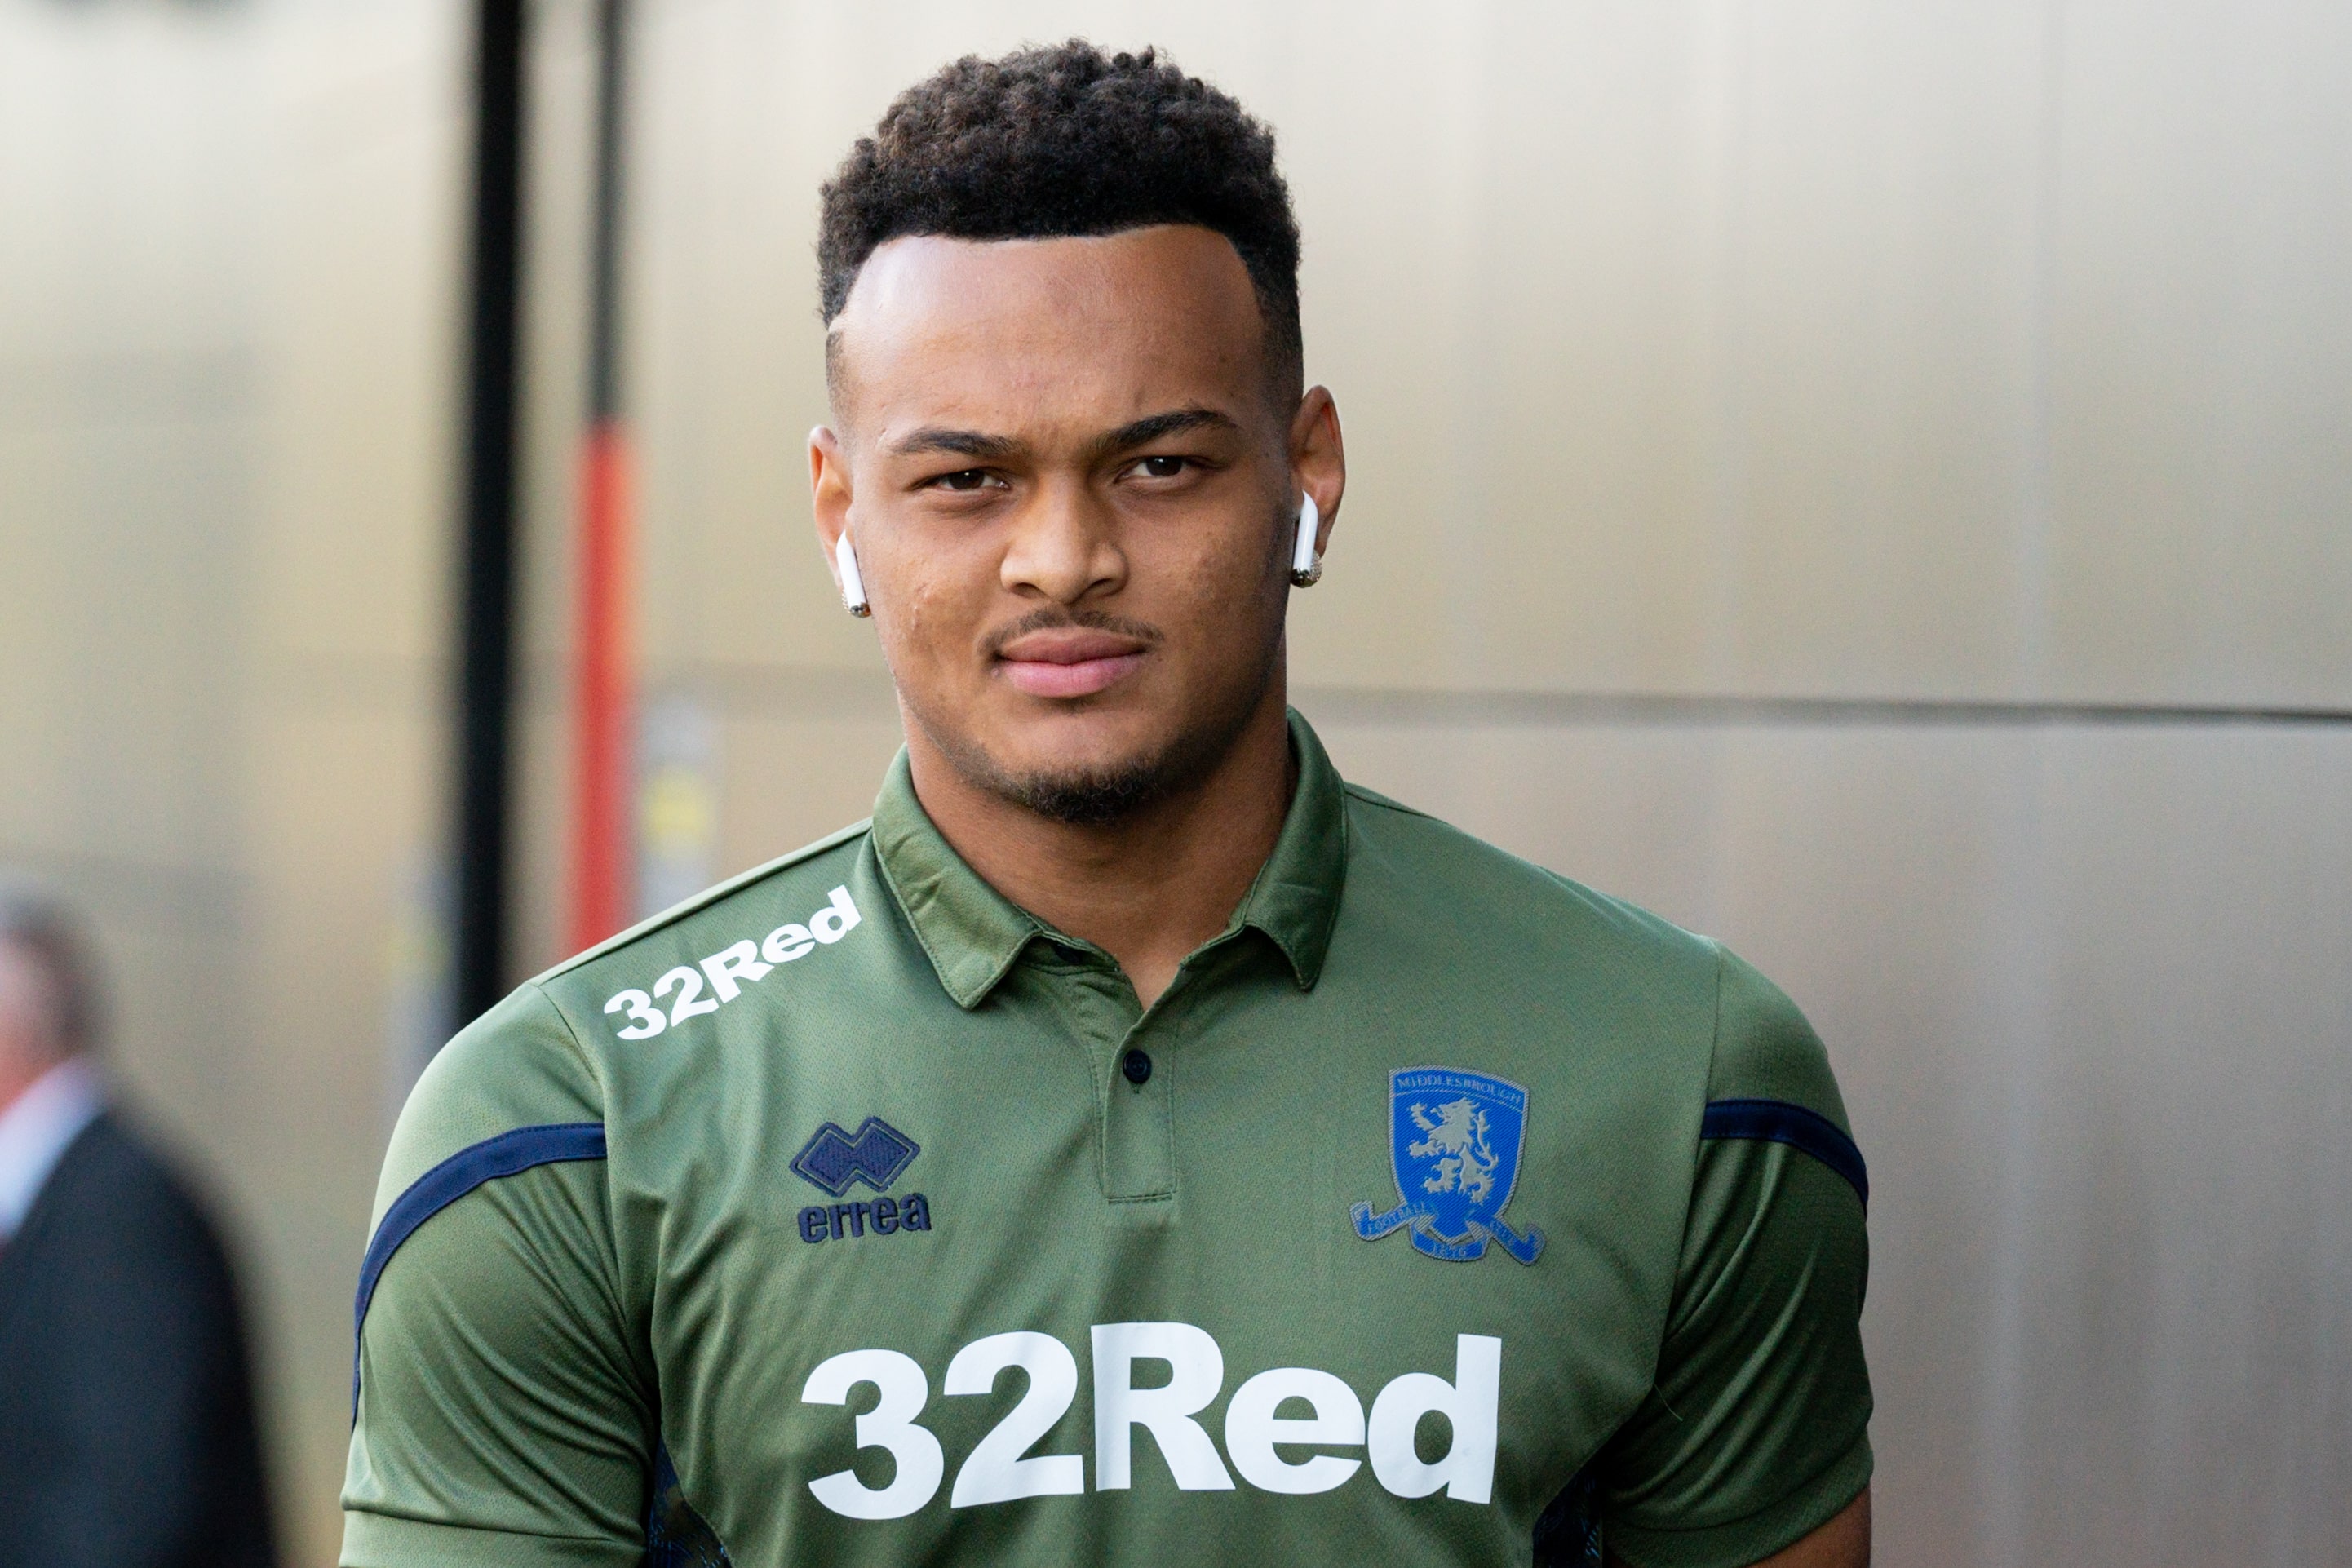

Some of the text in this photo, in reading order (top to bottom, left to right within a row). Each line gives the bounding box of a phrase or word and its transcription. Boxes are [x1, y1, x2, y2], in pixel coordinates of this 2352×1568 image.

[604, 884, 862, 1040] 32Red
[1397, 1074, 1522, 1105] MIDDLESBROUGH
[797, 1192, 932, 1243] errea
[801, 1322, 1503, 1520] 32Red
